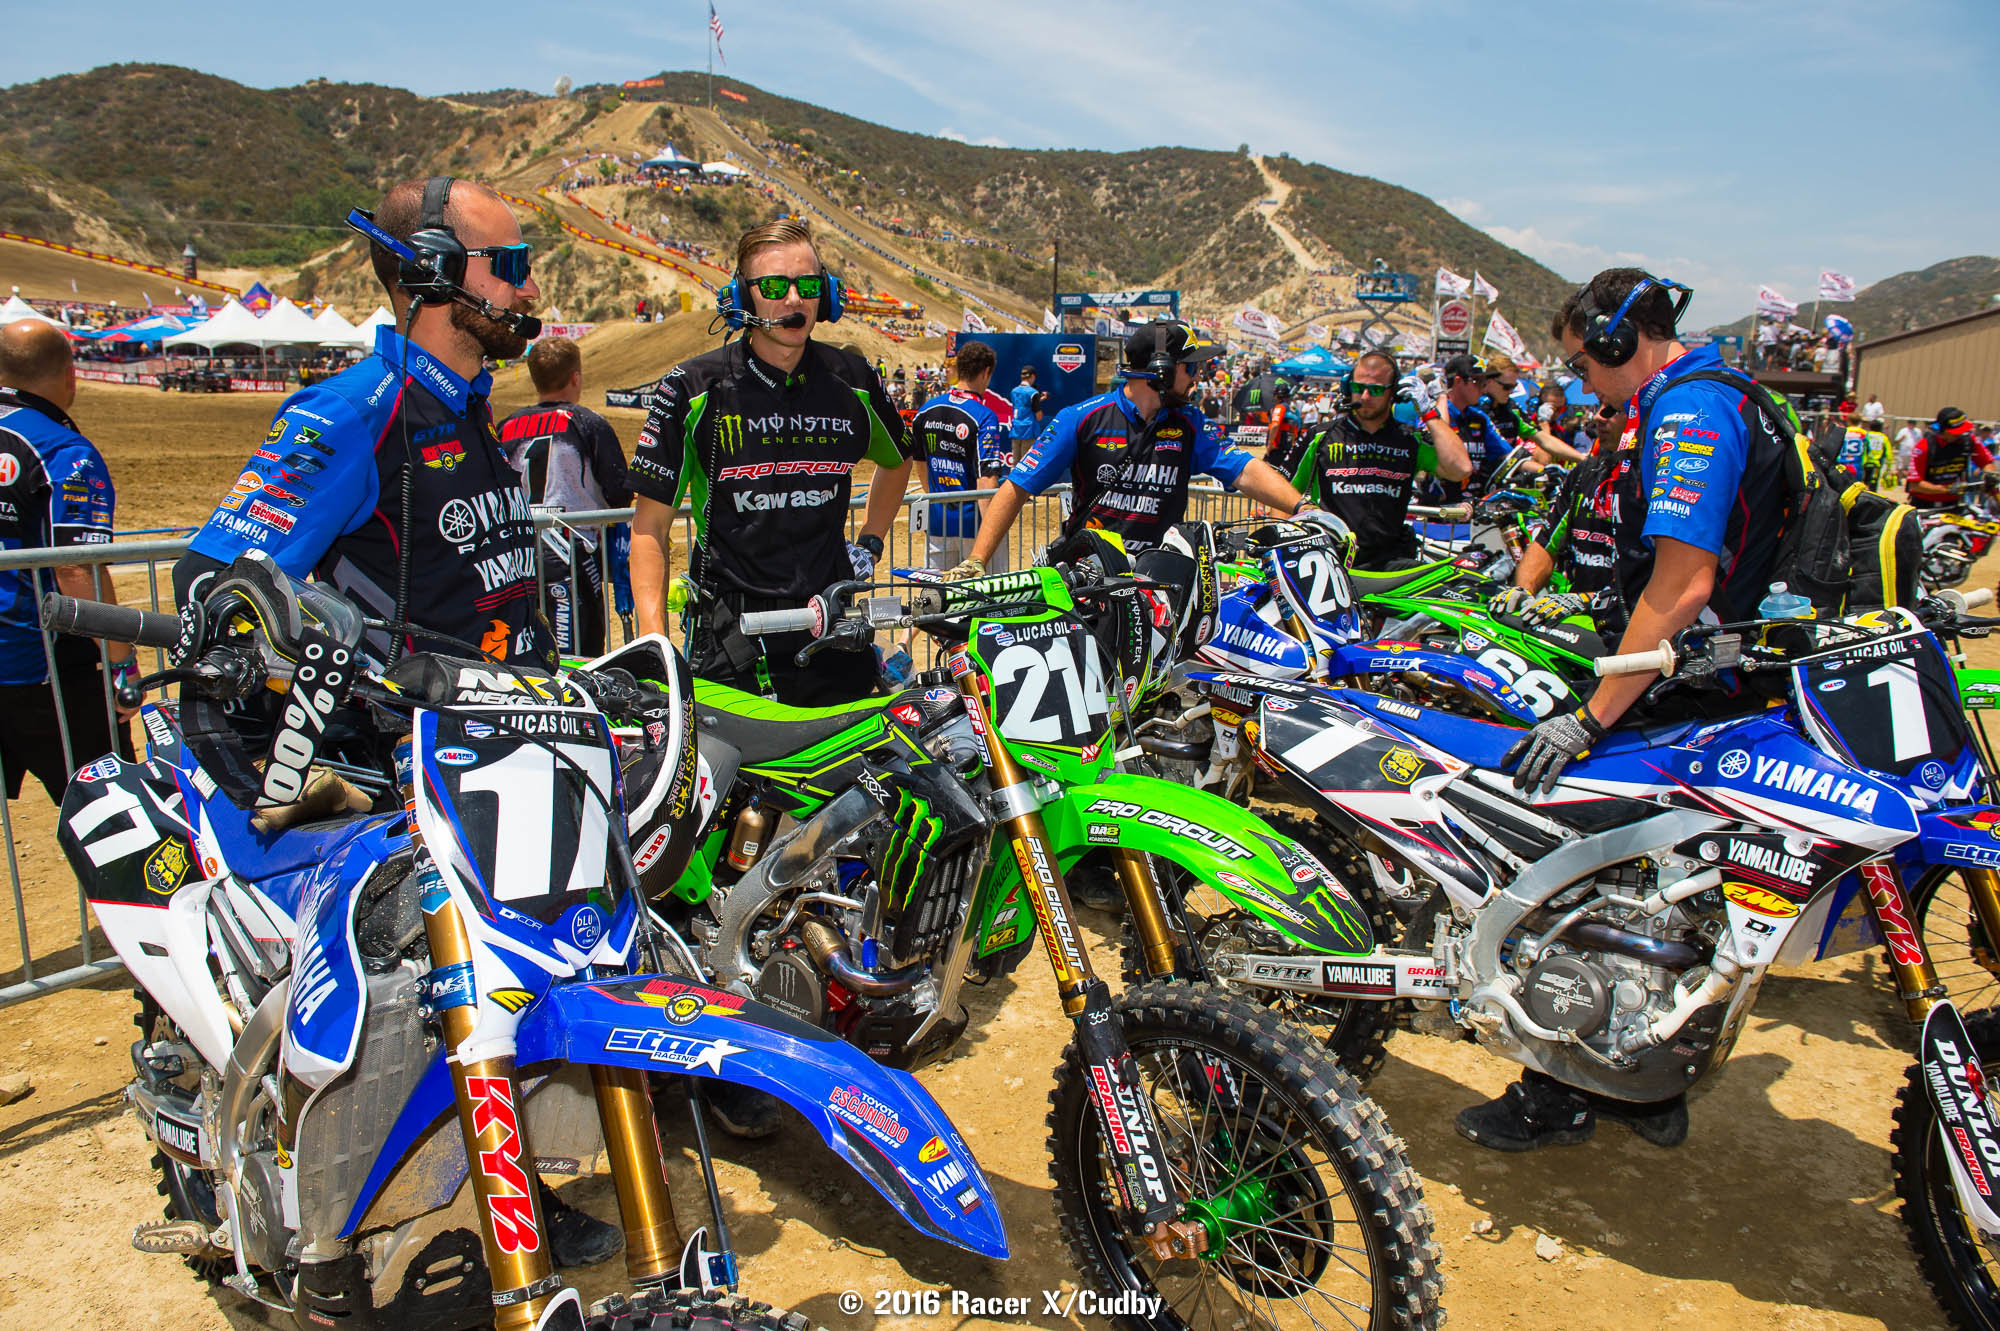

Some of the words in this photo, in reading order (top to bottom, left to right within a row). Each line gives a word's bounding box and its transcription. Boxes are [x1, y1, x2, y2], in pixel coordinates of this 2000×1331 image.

[425, 362, 459, 397] YAMAHA
[748, 358, 777, 389] Kawasaki
[650, 405, 673, 419] COTT
[762, 436, 839, 445] ENERGY
[523, 435, 552, 507] 1
[632, 456, 675, 480] NSTER
[718, 463, 774, 481] PRO
[1120, 463, 1179, 486] AMAHA
[220, 511, 269, 543] YAMAHA
[250, 504, 294, 531] ESCONDIDO
[916, 510, 923, 531] 5
[73, 532, 110, 543] JGR
[556, 599, 571, 650] YAMAHA
[1016, 624, 1053, 642] LUCAS
[1054, 621, 1071, 636] OIL
[1222, 624, 1287, 660] YAMAHA
[1889, 639, 1907, 654] OIL
[457, 689, 558, 706] NEKE
[992, 634, 1109, 743] 214
[1210, 683, 1254, 708] YAMALUBE
[1212, 673, 1307, 692] DUNLOP
[499, 714, 558, 735] LUCAS
[560, 715, 580, 735] OIL
[1376, 698, 1422, 720] YAMAHA
[1867, 657, 1932, 762] 1
[142, 709, 175, 747] DUNLOP
[857, 769, 891, 806] KX
[1753, 755, 1880, 814] YAMAHA
[460, 741, 613, 902] 17
[1085, 799, 1143, 818] PRO
[1138, 809, 1256, 863] CIRCUIT
[634, 833, 666, 868] BELL
[1727, 838, 1817, 885] YAMALUBE
[1296, 865, 1313, 879] BELL
[1026, 836, 1055, 884] PRO
[1044, 886, 1085, 973] CIRCUIT
[1724, 883, 1799, 914] FMF
[1860, 862, 1924, 966] KYB
[1031, 889, 1064, 972] SHOWA
[1252, 963, 1313, 980] GYTR
[1326, 964, 1391, 986] YAMALUBE
[1408, 967, 1446, 976] BRAKI
[1412, 978, 1449, 988] EXC
[641, 978, 690, 994] MICKEY
[687, 985, 748, 1010] THOMPSON
[677, 1002, 693, 1010] M/T
[1534, 982, 1593, 1004] REKLUSE
[771, 1003, 802, 1021] Kawasaki
[653, 1052, 698, 1063] RACING
[861, 1092, 899, 1121] TOYOTA
[1924, 1060, 1961, 1123] YAMALUBE
[829, 1085, 910, 1145] ESCONDIDO
[1091, 1065, 1131, 1155] BRAKING
[157, 1116, 198, 1156] YAMALUBE
[828, 1102, 863, 1128] ACTION
[863, 1122, 901, 1150] SPORTS
[465, 1076, 540, 1255] KYB
[551, 1159, 576, 1170] Air
[1952, 1127, 1992, 1197] BRAKING
